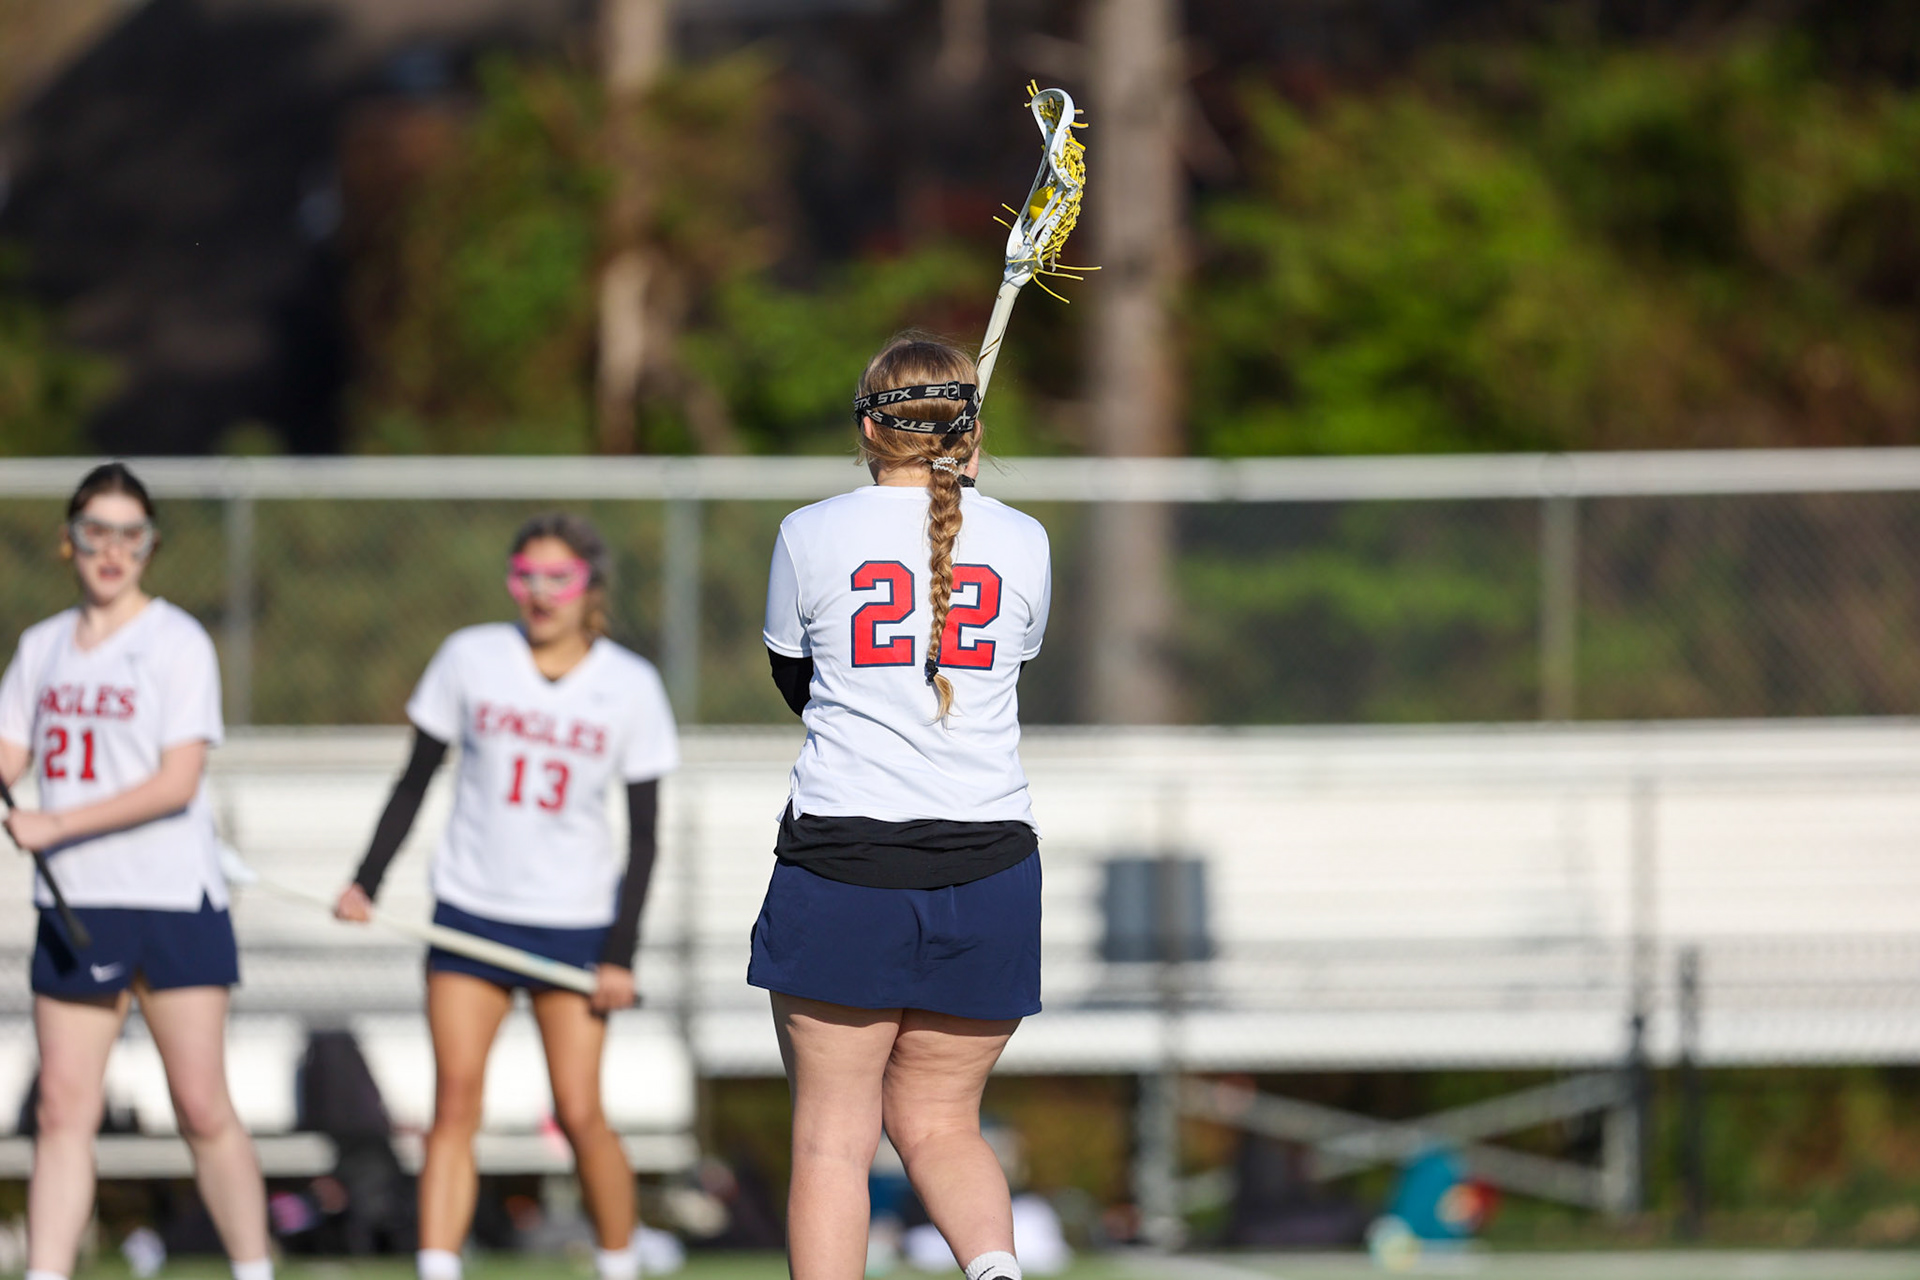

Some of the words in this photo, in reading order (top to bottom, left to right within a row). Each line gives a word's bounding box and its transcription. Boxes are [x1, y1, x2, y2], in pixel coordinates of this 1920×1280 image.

[878, 388, 912, 405] STX
[893, 418, 937, 432] STX
[850, 560, 1002, 671] 22
[43, 724, 96, 781] 21
[474, 702, 608, 759] EAGLES
[506, 752, 571, 814] 13
